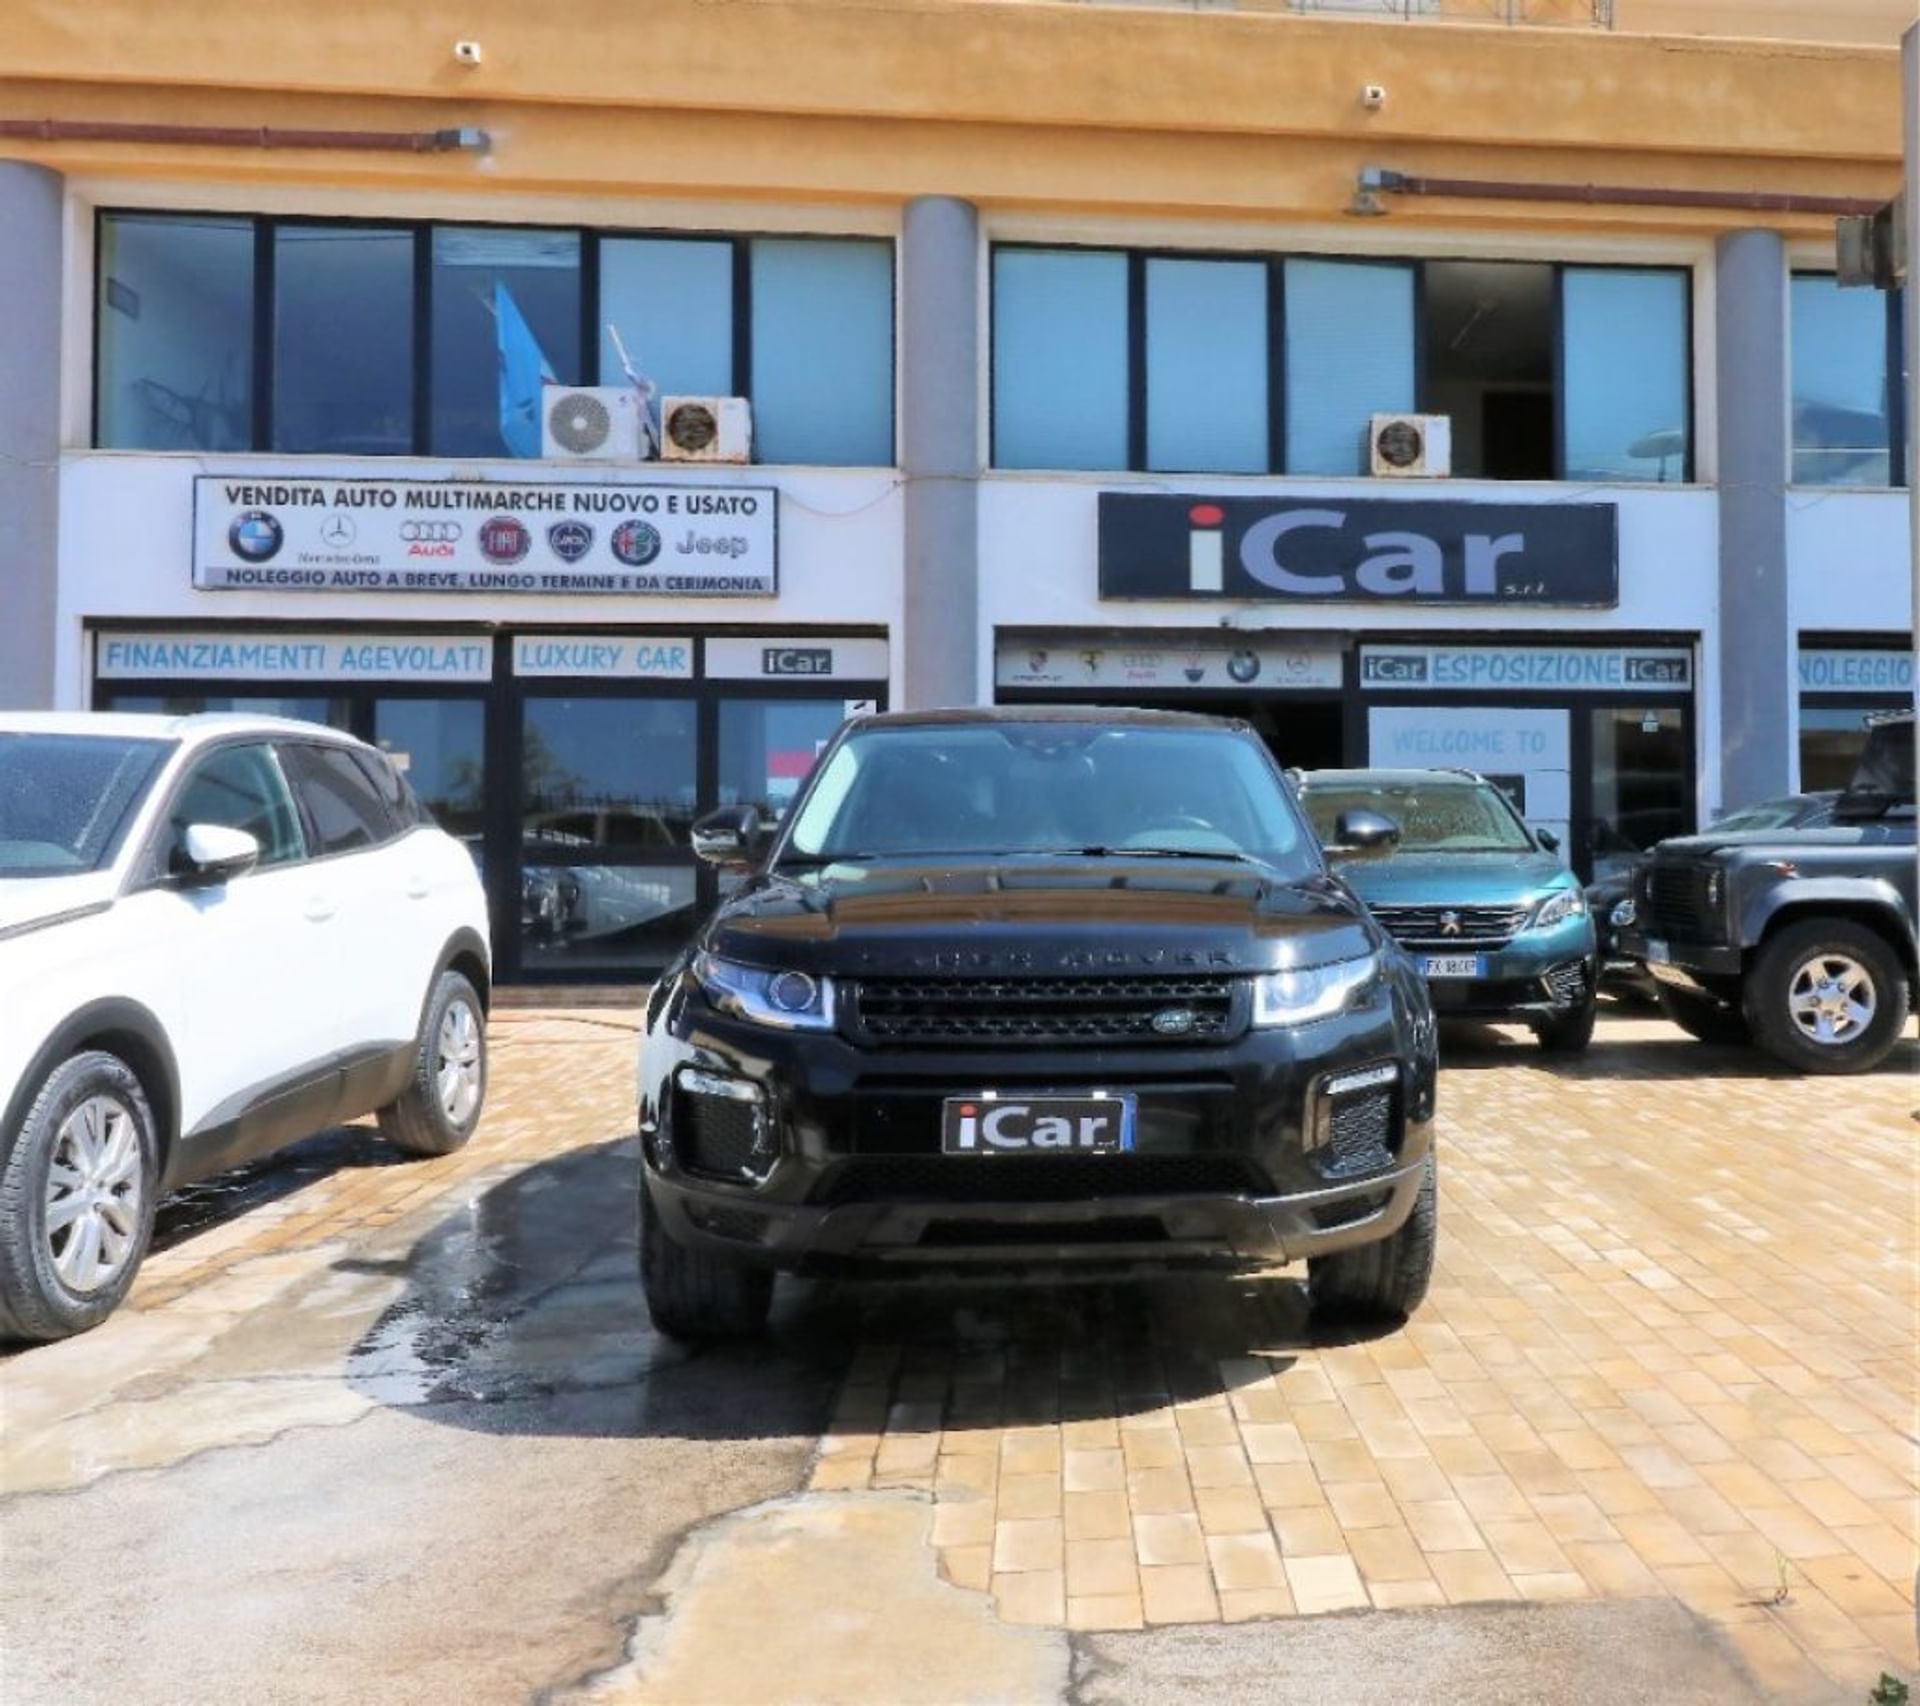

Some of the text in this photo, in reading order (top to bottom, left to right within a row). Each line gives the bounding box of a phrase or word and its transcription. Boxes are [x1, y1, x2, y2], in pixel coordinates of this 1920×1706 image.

[226, 486, 758, 516] VENDITA AUTO MULTIMARCHE NUOVO E USATO
[408, 544, 456, 558] Audi
[675, 530, 750, 559] Jeep
[1189, 504, 1525, 594] iCar
[226, 569, 326, 585] NOLEGGIO
[331, 571, 381, 585] AUTO
[386, 572, 399, 585] A
[469, 574, 536, 588] LUNGO
[541, 575, 615, 589] TERMINE
[620, 577, 630, 589] E
[636, 577, 660, 590] DA
[665, 577, 763, 591] CERIMONIA
[105, 642, 484, 671] FINANZIAMENTI AGEVOLATI
[519, 644, 686, 670] LUXURY CAR
[767, 650, 827, 673] iCar
[1367, 654, 1684, 682] iCar ESPOSIZIONE iCar
[1799, 656, 1912, 686] NOLEGGIO
[1392, 729, 1546, 753] WELCOME TO
[959, 1103, 1108, 1148] iCar
